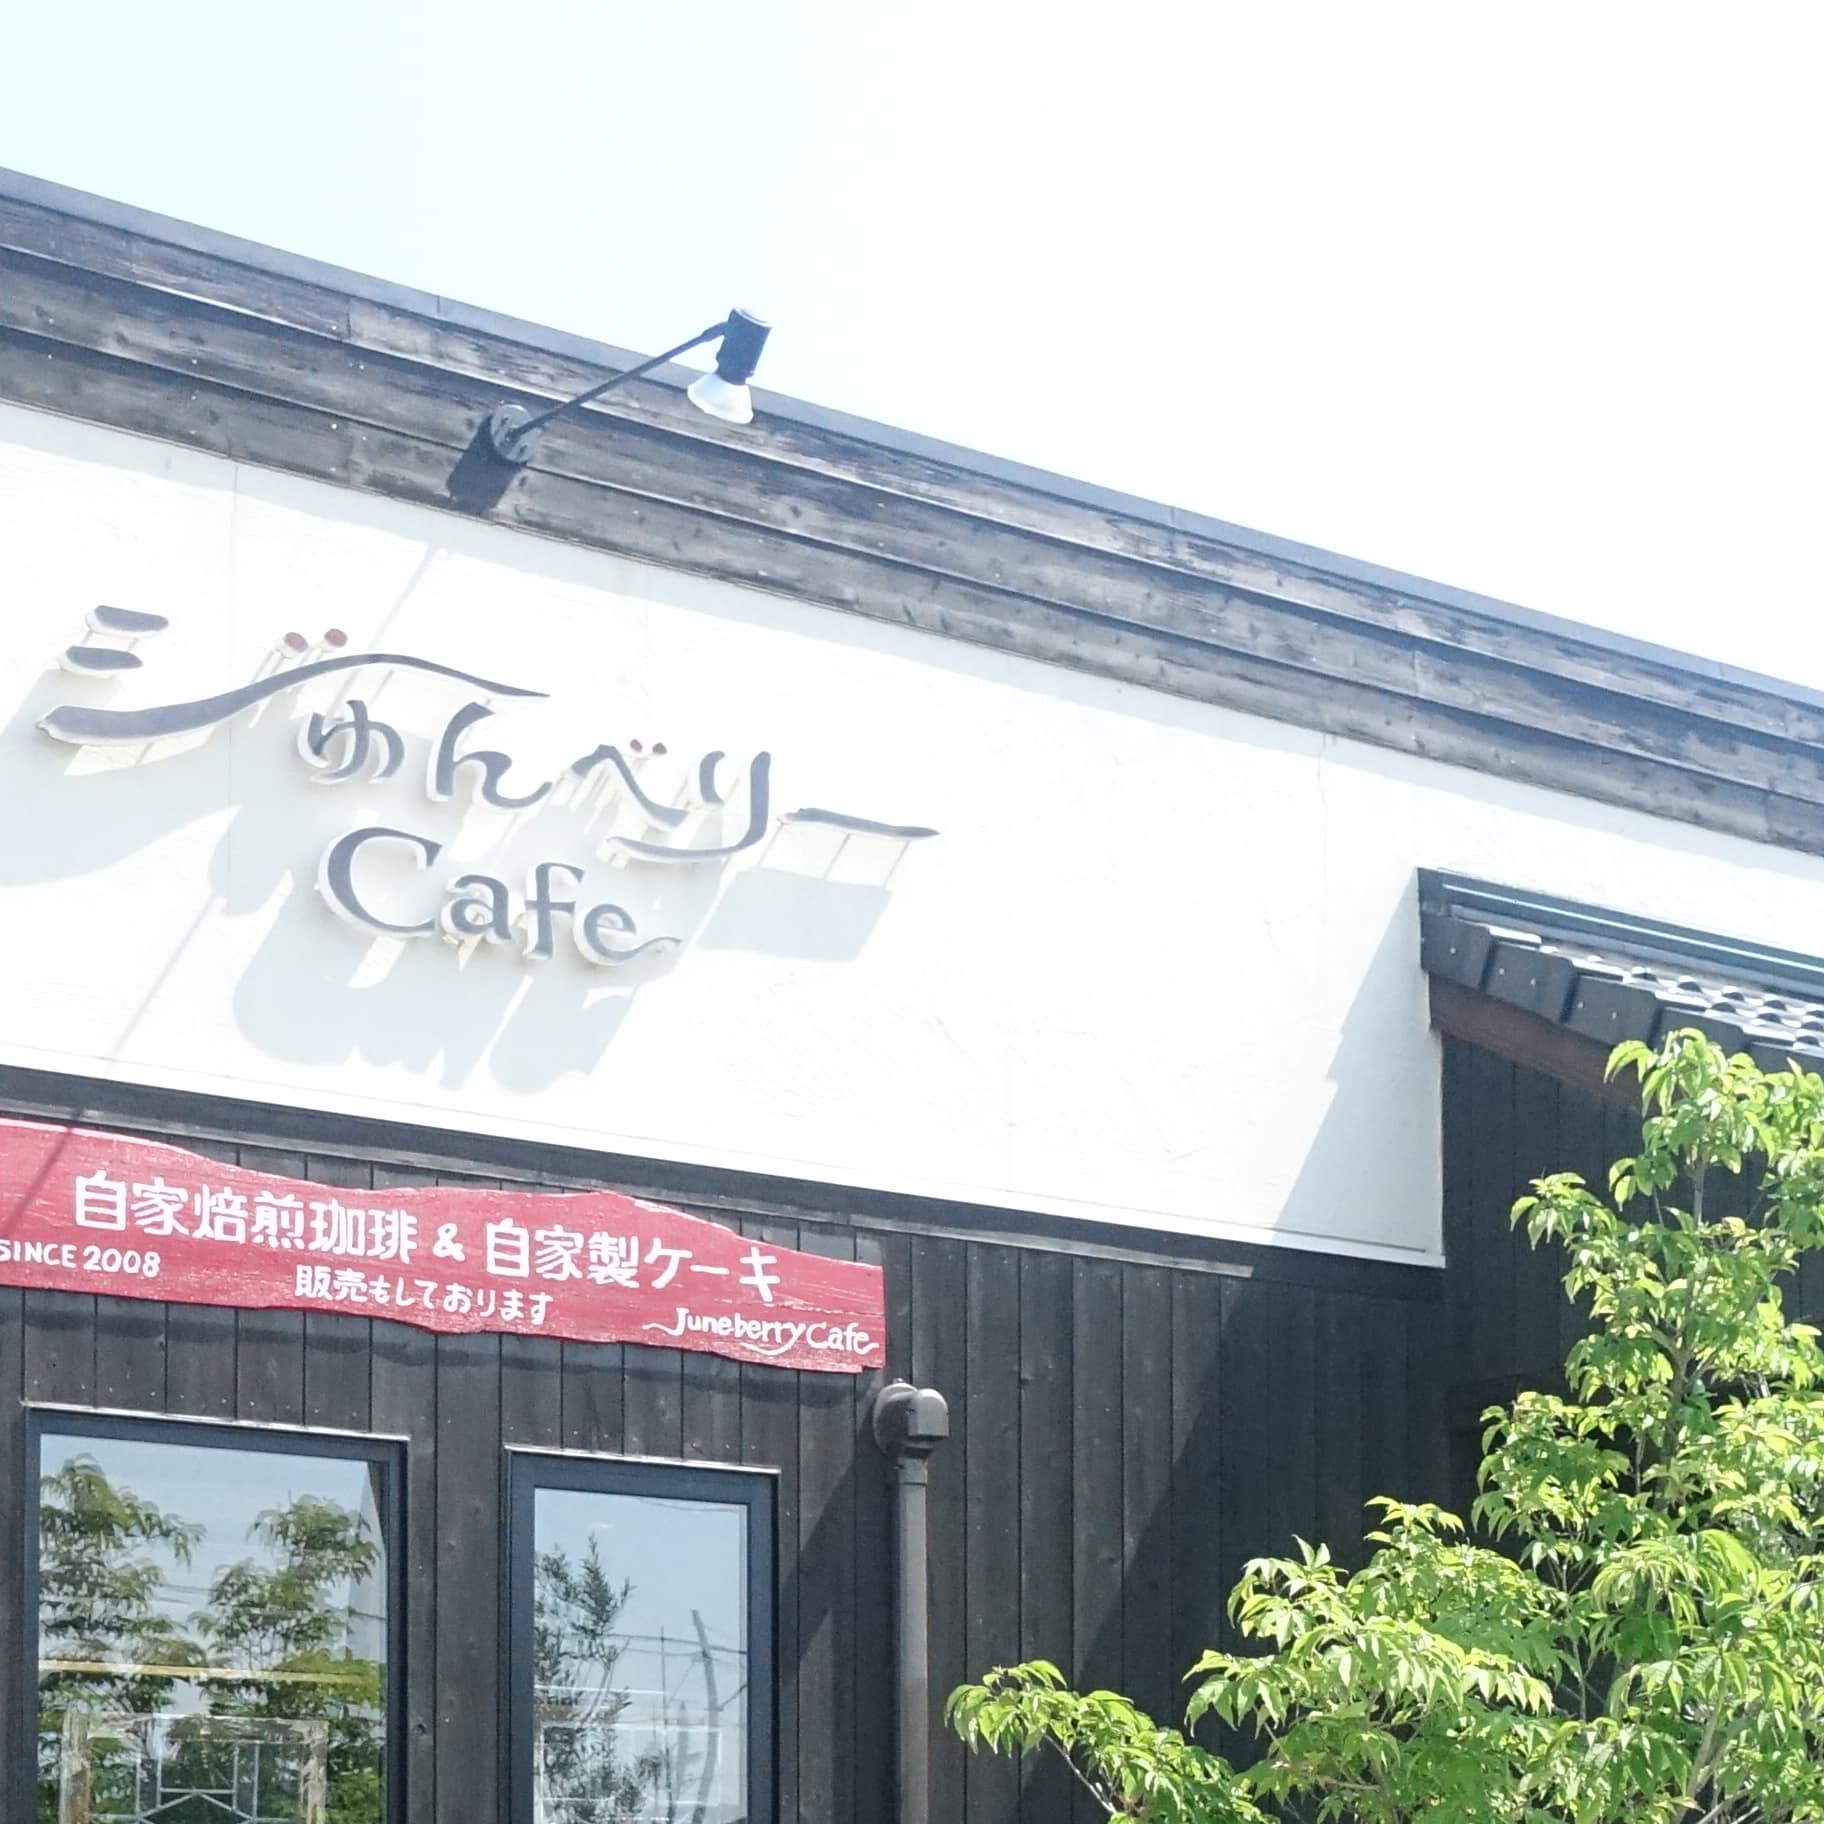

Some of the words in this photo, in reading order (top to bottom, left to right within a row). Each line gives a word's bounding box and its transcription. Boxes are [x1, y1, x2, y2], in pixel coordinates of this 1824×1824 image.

[316, 826, 680, 968] Cafe
[74, 1169, 419, 1265] 自家焙煎珈琲
[432, 1222, 466, 1263] &
[484, 1216, 782, 1303] 自家製ケーキ
[82, 1244, 162, 1278] 2008
[294, 1264, 554, 1326] 販売もしております
[805, 1321, 880, 1355] Cafe
